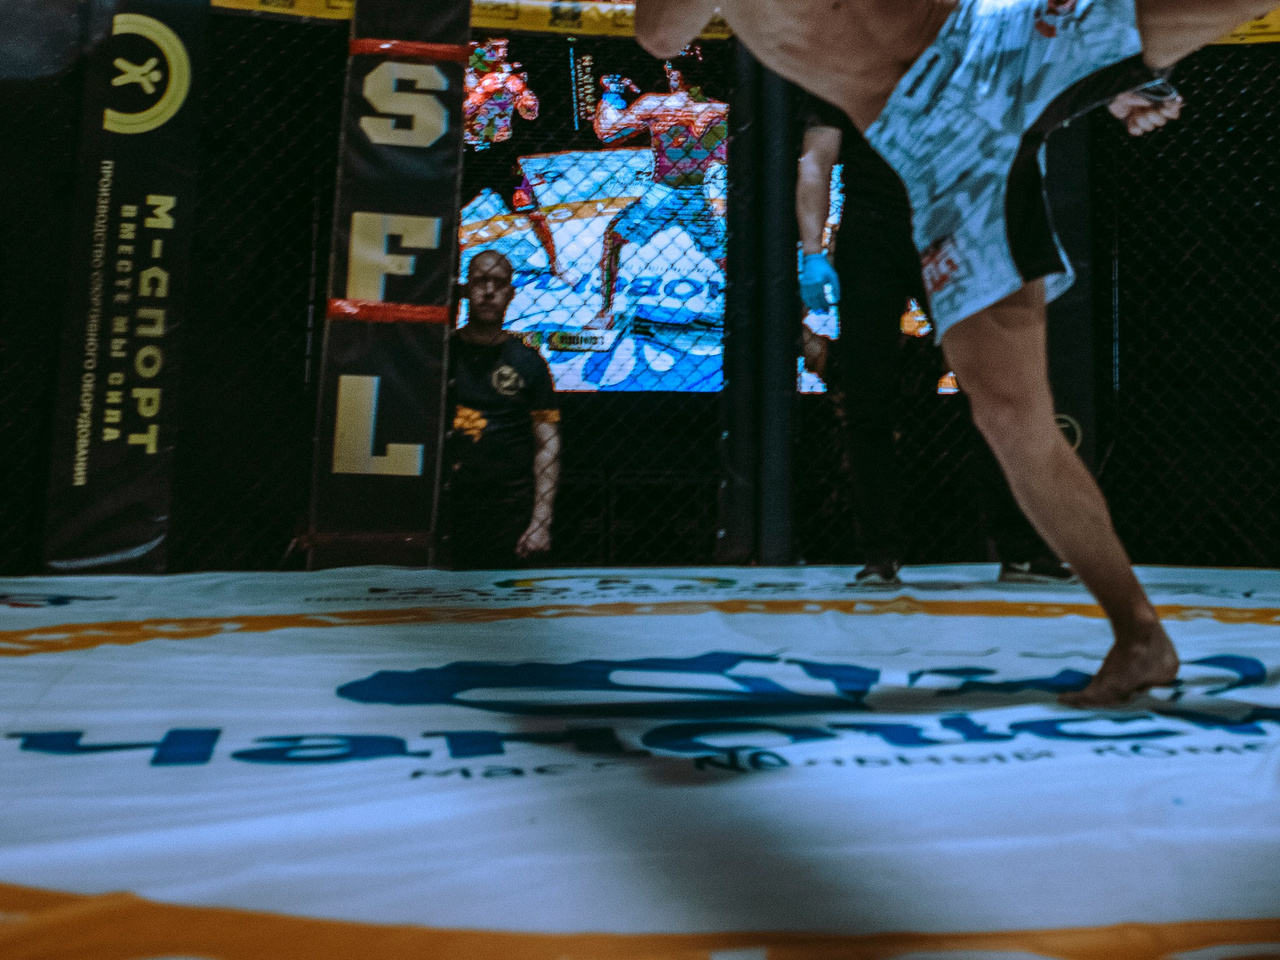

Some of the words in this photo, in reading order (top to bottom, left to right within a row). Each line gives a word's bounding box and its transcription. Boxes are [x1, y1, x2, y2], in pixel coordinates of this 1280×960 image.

[113, 205, 138, 303] ВМЕСТЕ
[110, 316, 129, 357] МЫ
[127, 195, 176, 454] М-СПОРТ
[102, 372, 125, 441] СИЛА
